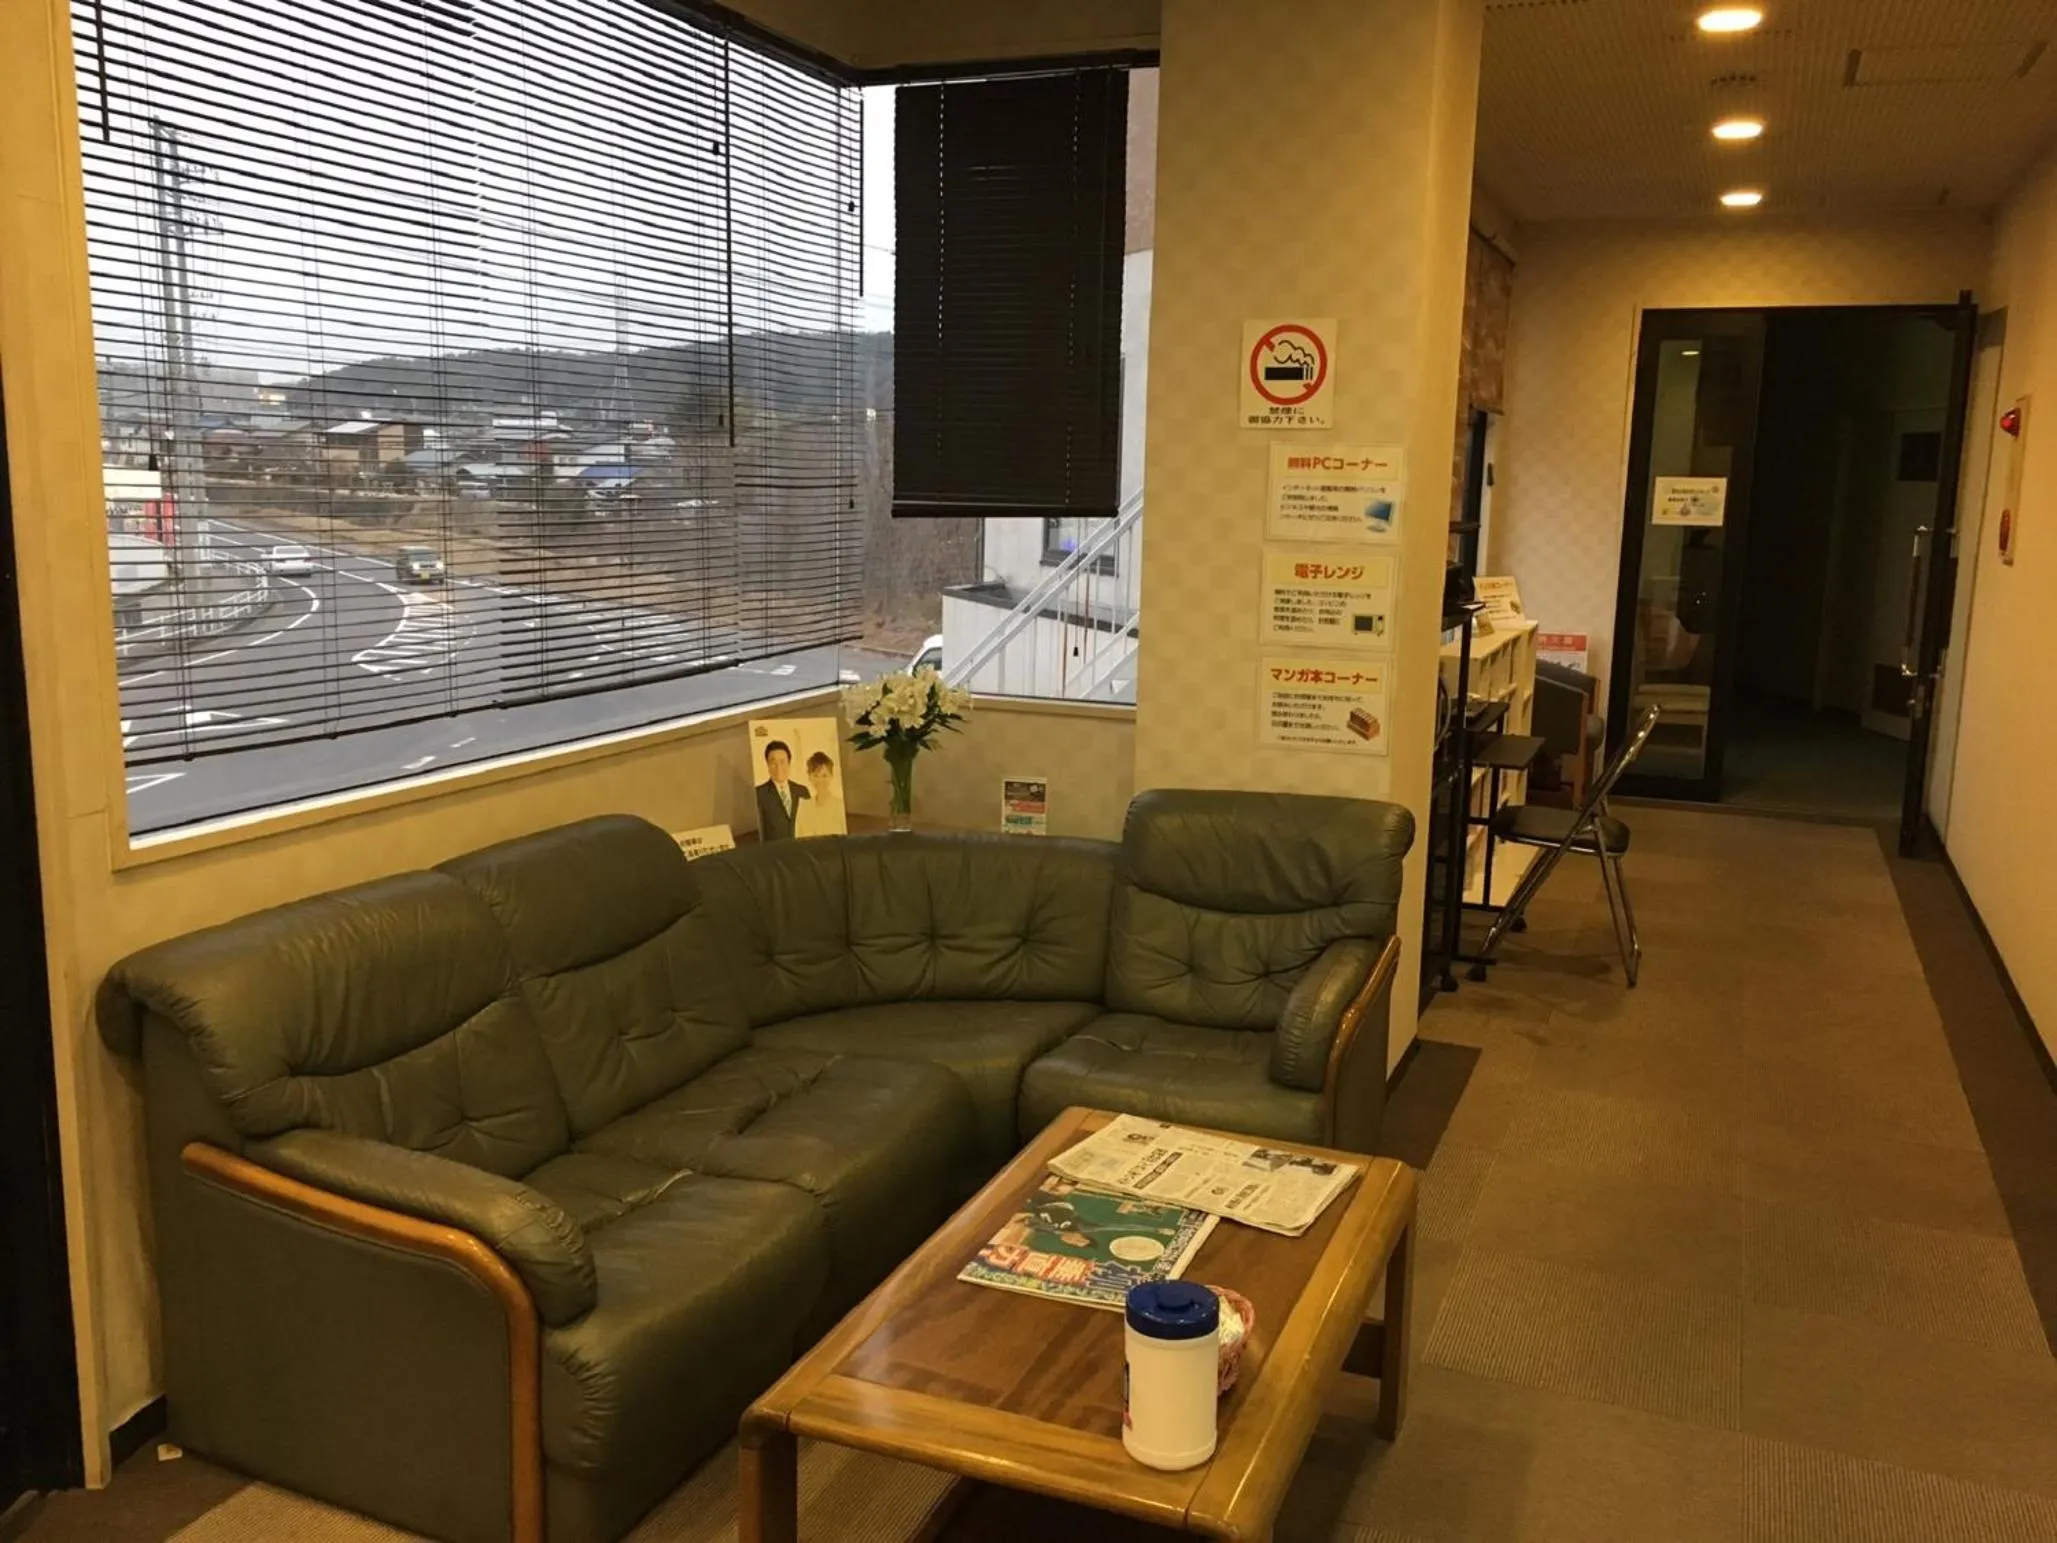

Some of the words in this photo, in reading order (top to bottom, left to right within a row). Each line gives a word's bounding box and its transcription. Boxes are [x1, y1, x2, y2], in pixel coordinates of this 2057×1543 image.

[1294, 563, 1365, 580] 電子レンジ
[1270, 667, 1378, 685] マンガ本コーナー
